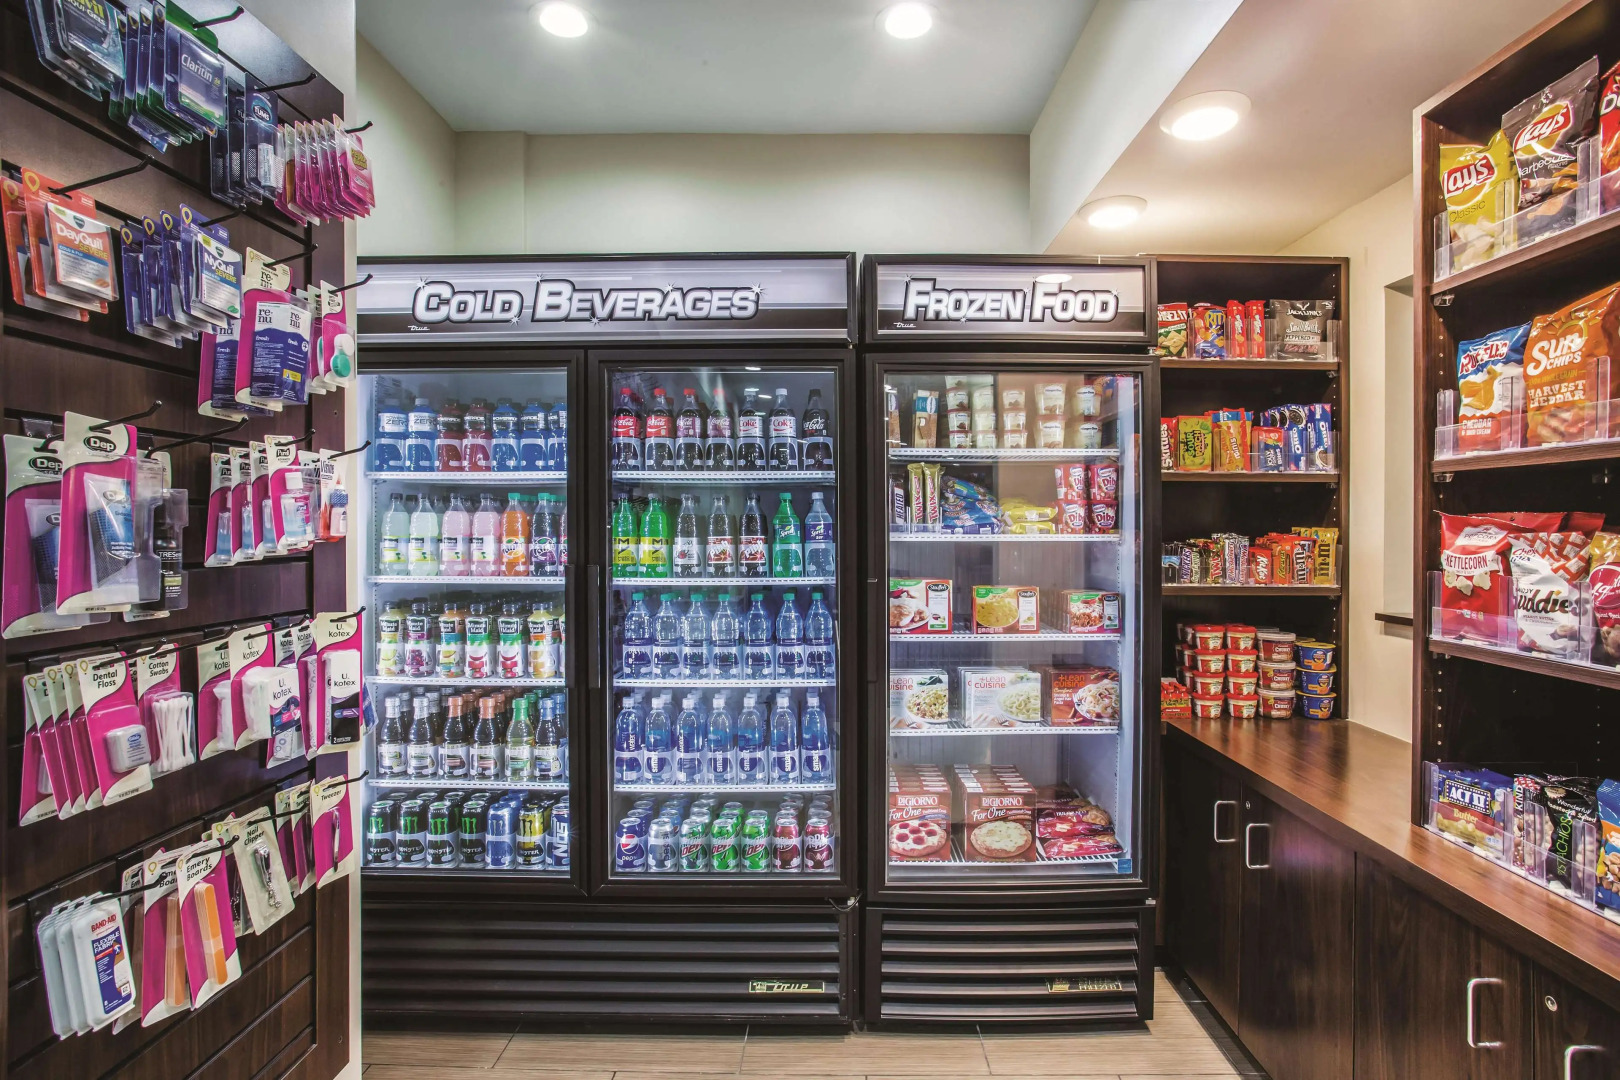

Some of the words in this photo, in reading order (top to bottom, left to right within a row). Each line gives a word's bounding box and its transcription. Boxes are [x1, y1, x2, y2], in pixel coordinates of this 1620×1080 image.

[181, 53, 213, 83] Claritin
[254, 105, 270, 121] TUMS
[1521, 154, 1568, 176] arbecue
[1446, 159, 1490, 195] Lay's
[1449, 200, 1486, 223] Classic
[55, 222, 103, 250] DayQuil
[79, 242, 109, 261] SEVERE
[204, 252, 234, 276] NyQuil
[215, 268, 237, 284] SEVERE
[413, 281, 523, 324] COLD
[531, 279, 760, 323] BEVERAGES
[903, 277, 1027, 322] FROZEN
[1029, 278, 1119, 323] FOOD
[1545, 351, 1582, 370] CHIPS
[1528, 380, 1586, 398] HARVEST
[773, 420, 791, 428] Coke
[1462, 417, 1492, 429] CHEDDAR
[91, 438, 114, 450] Dep
[1186, 432, 1195, 457] SOUR
[914, 494, 924, 524] TWIX
[928, 494, 939, 524] TWIX
[1096, 511, 1115, 522] Dibs
[1256, 555, 1268, 580] KitKat
[1445, 555, 1488, 570] KETTLECORN
[328, 630, 350, 638] kotex
[242, 649, 260, 660] kotex
[148, 660, 169, 670] Cotton
[150, 668, 169, 678] Swabs
[93, 670, 118, 683] Dental
[97, 680, 117, 689] Floss
[892, 677, 914, 685] Lean
[272, 687, 292, 701] kotex
[320, 789, 342, 802] Tweezer
[1449, 786, 1472, 803] ACT
[1515, 784, 1523, 810] KIND
[903, 806, 922, 818] One
[971, 808, 987, 821] For
[987, 806, 1006, 818] One
[1557, 798, 1592, 814] Wonderful
[1453, 808, 1478, 824] Butter
[244, 830, 266, 846] Clipper
[246, 827, 259, 838] Nail
[555, 820, 568, 857] NOS
[186, 857, 211, 874] Emery
[186, 863, 213, 882] Boards
[90, 914, 117, 933] BAND-AID
[93, 931, 121, 949] FLEXIBLE
[94, 939, 116, 954] FABRIC
